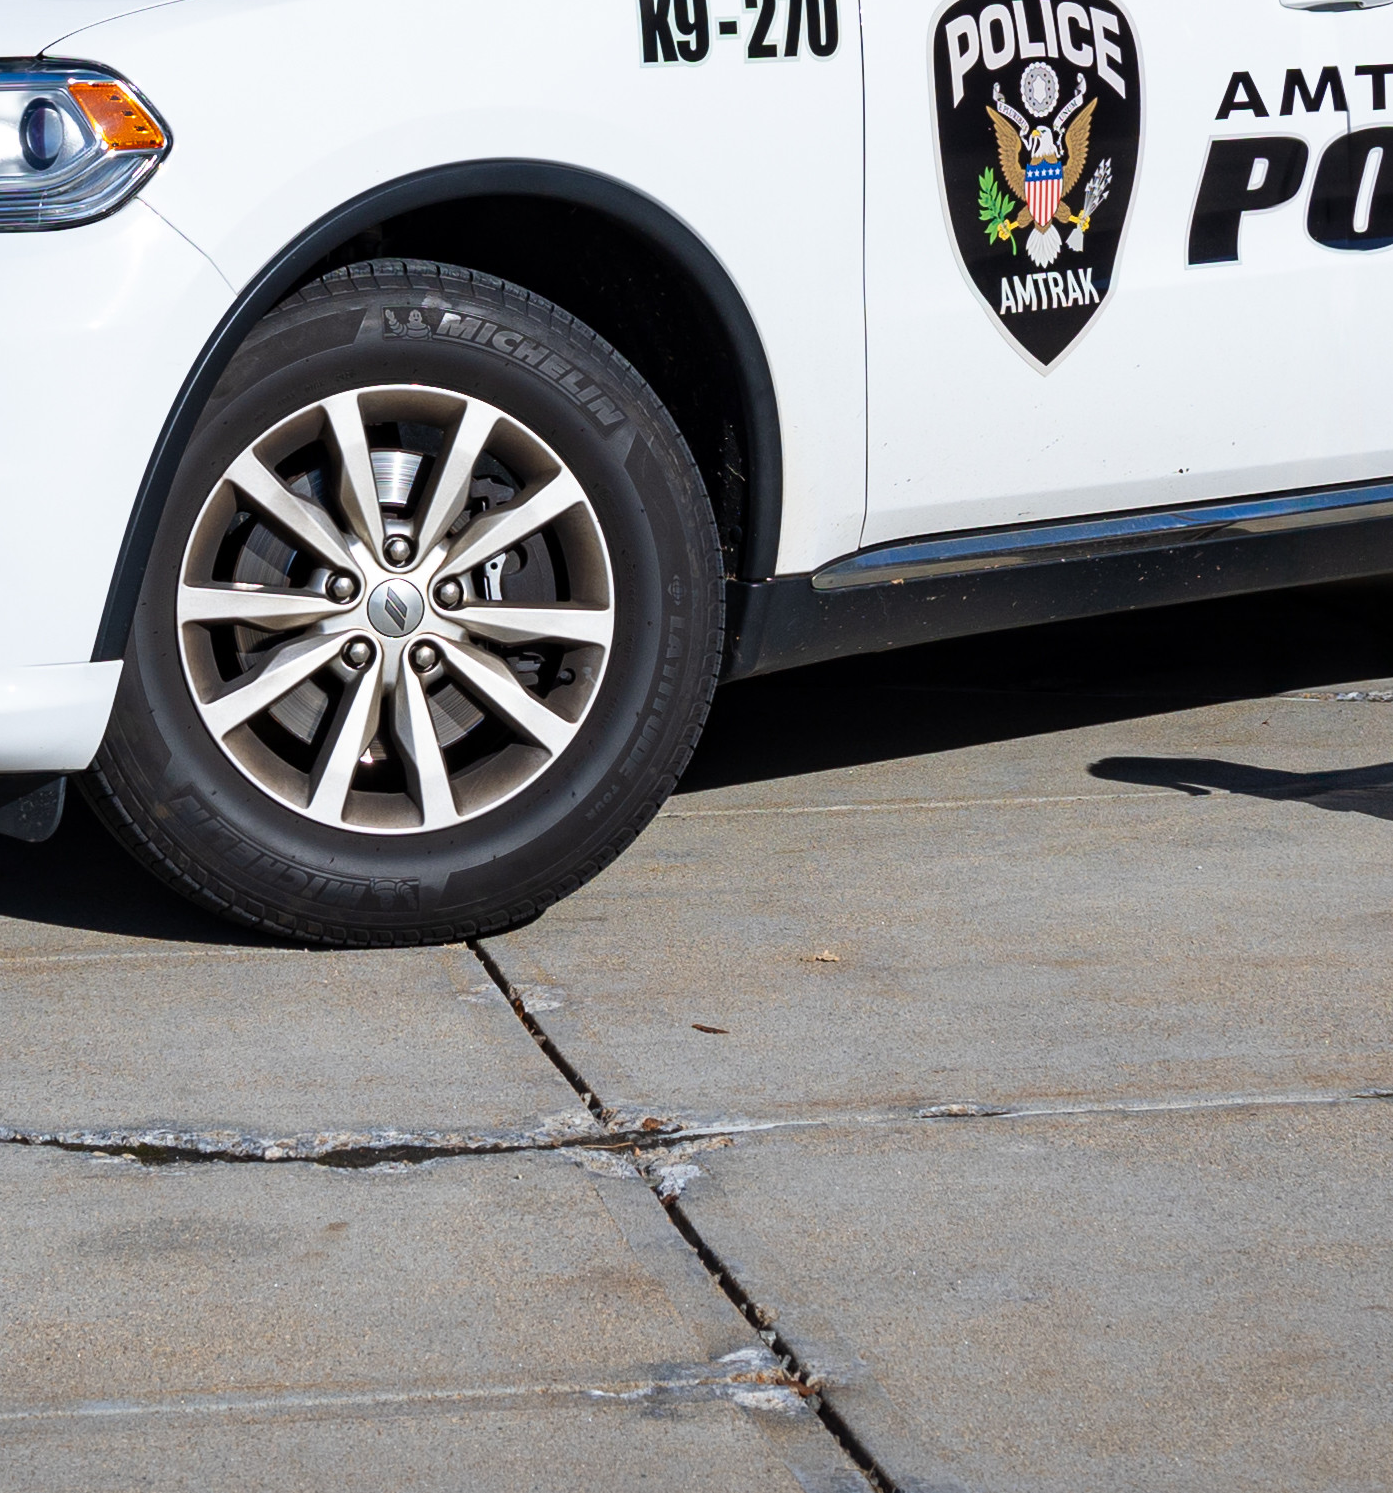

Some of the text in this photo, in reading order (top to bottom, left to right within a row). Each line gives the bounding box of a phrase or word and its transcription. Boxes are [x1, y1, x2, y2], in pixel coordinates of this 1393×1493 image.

[946, 0, 1126, 108] POLICE
[1058, 100, 1078, 122] UNUM
[999, 268, 1100, 314] AMTRAK
[436, 312, 626, 427] MICHELIN
[618, 615, 684, 780] LATITUDE
